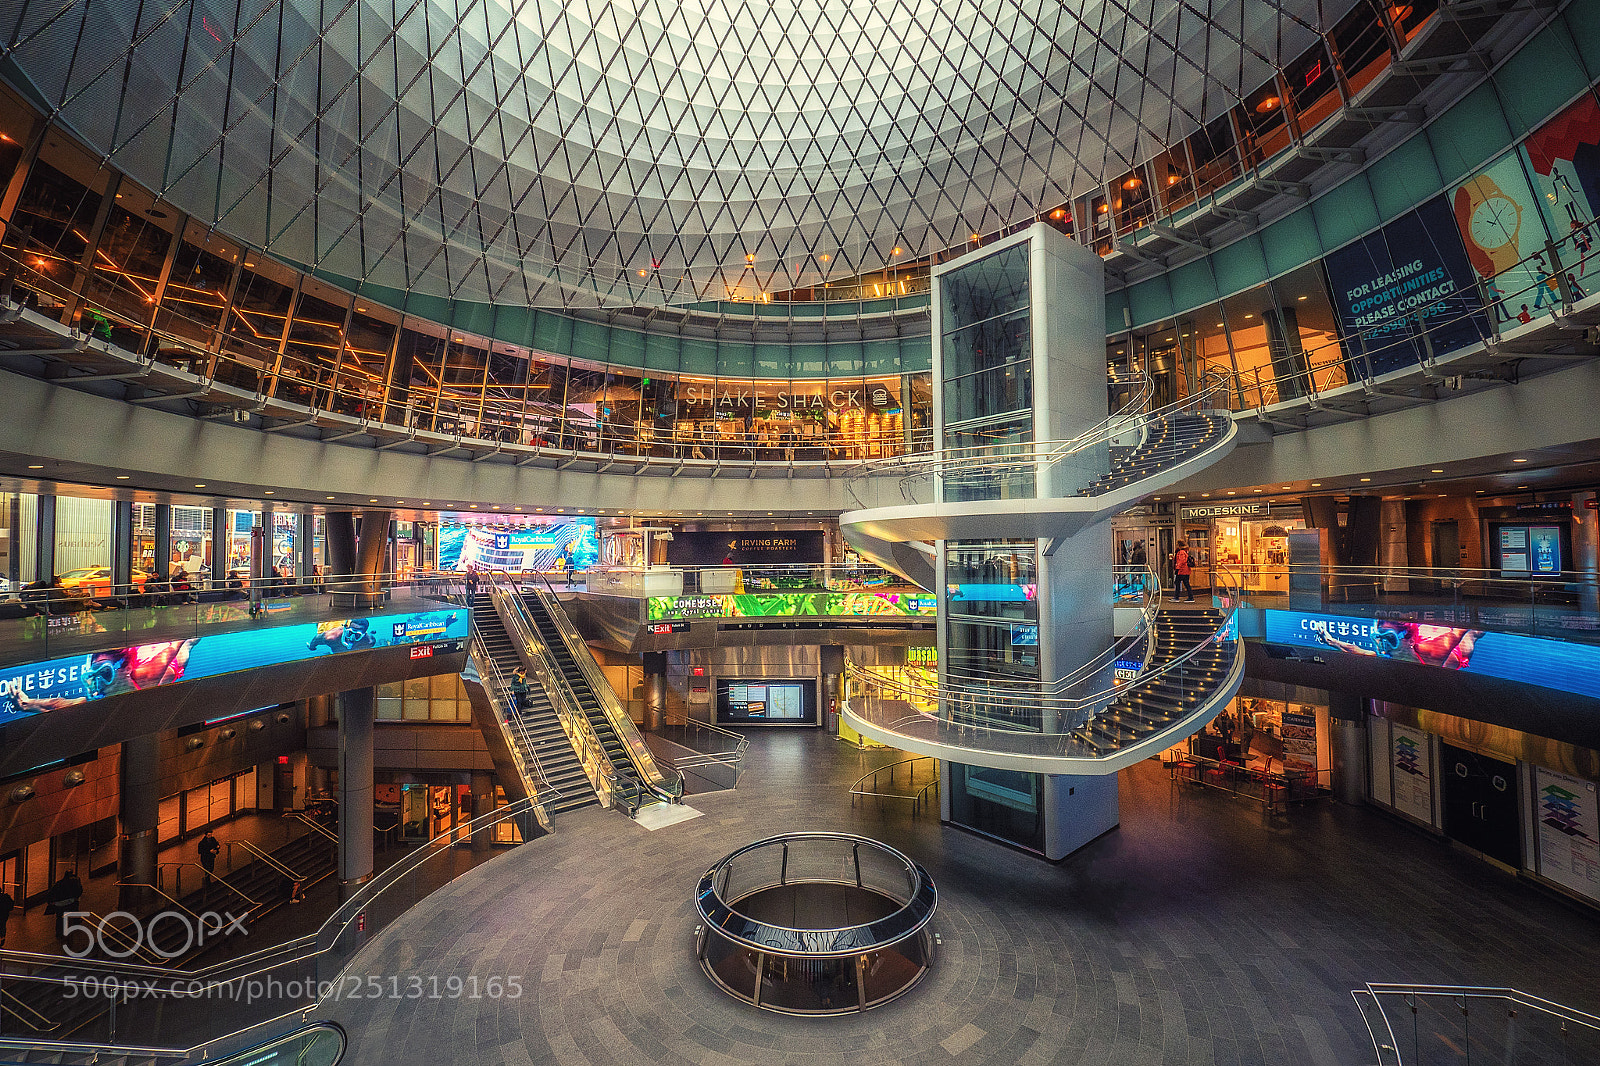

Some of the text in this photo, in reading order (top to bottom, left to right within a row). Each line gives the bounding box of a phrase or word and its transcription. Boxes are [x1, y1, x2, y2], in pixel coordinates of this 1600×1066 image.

[1347, 260, 1423, 301] FOR LEASING
[1351, 267, 1445, 314] OPPORTUNITIES
[1355, 280, 1455, 328] PLEASE CONTACT
[685, 387, 861, 408] SHAKE SHACK
[1189, 505, 1260, 517] MOLESKINE
[673, 599, 697, 609] COME
[654, 624, 671, 633] Exit
[410, 646, 431, 658] Exit
[908, 646, 938, 661] wasab
